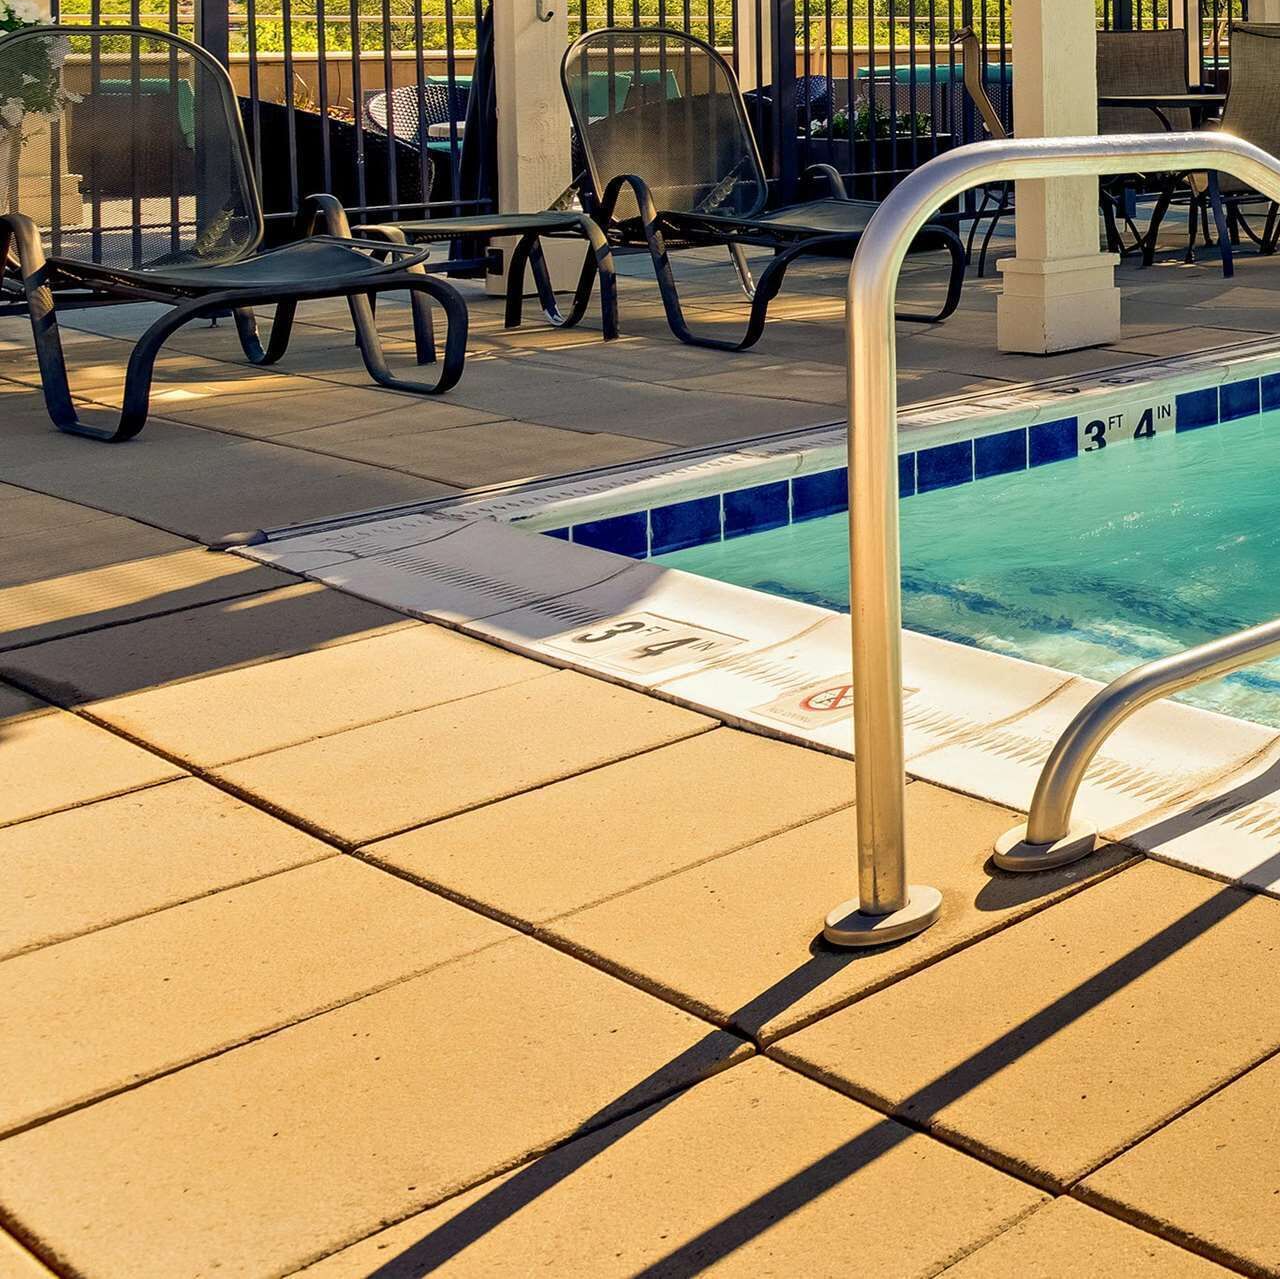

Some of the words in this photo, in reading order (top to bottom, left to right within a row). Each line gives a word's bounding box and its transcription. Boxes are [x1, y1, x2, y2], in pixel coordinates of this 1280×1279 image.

[1084, 420, 1107, 452] 3
[1108, 414, 1123, 431] FT
[1133, 407, 1156, 441] 4
[1157, 404, 1171, 420] IN
[571, 621, 646, 644] 3
[630, 637, 701, 659] 4
